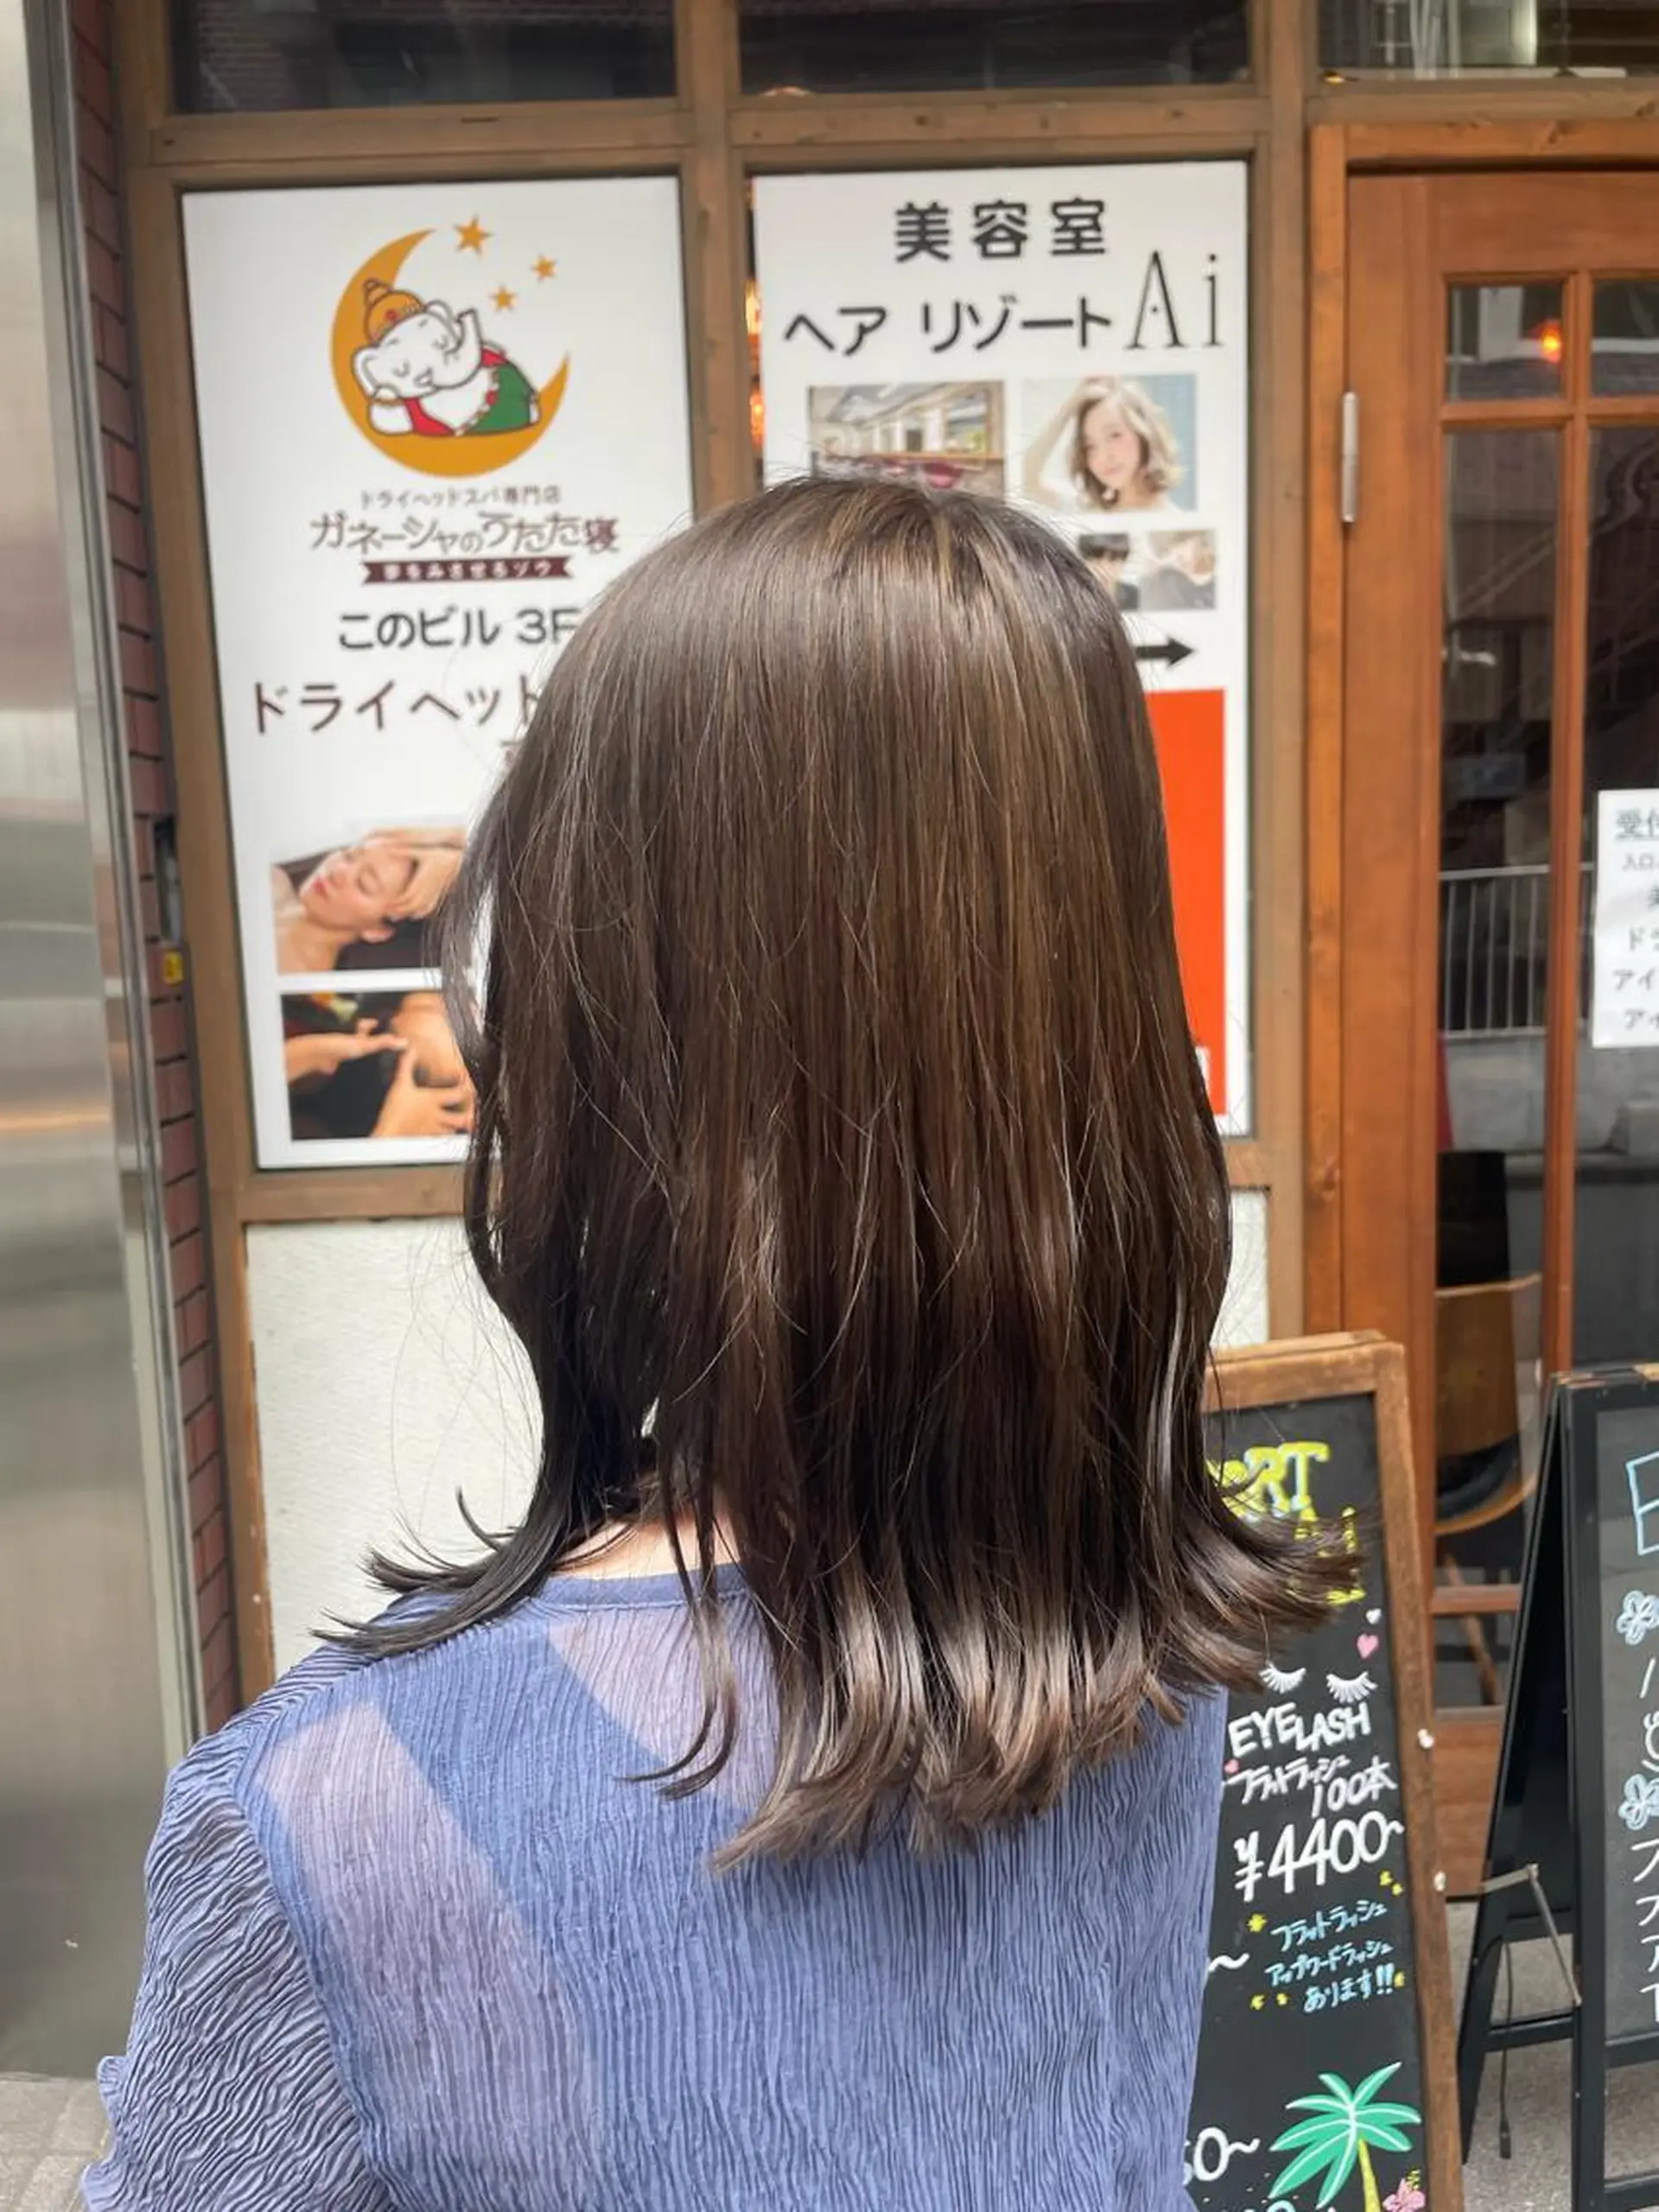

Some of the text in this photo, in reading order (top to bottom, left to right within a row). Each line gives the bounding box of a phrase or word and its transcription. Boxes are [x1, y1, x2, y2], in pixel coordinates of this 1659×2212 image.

[894, 196, 1107, 264] 美容室
[784, 305, 887, 357] ヘア
[922, 294, 1112, 353] リゾート
[308, 509, 620, 556] ガネーシャのうたた寝
[339, 605, 581, 650] このビル 3F
[1228, 1701, 1372, 1758] EYELASH
[1311, 1755, 1397, 1818] 100本
